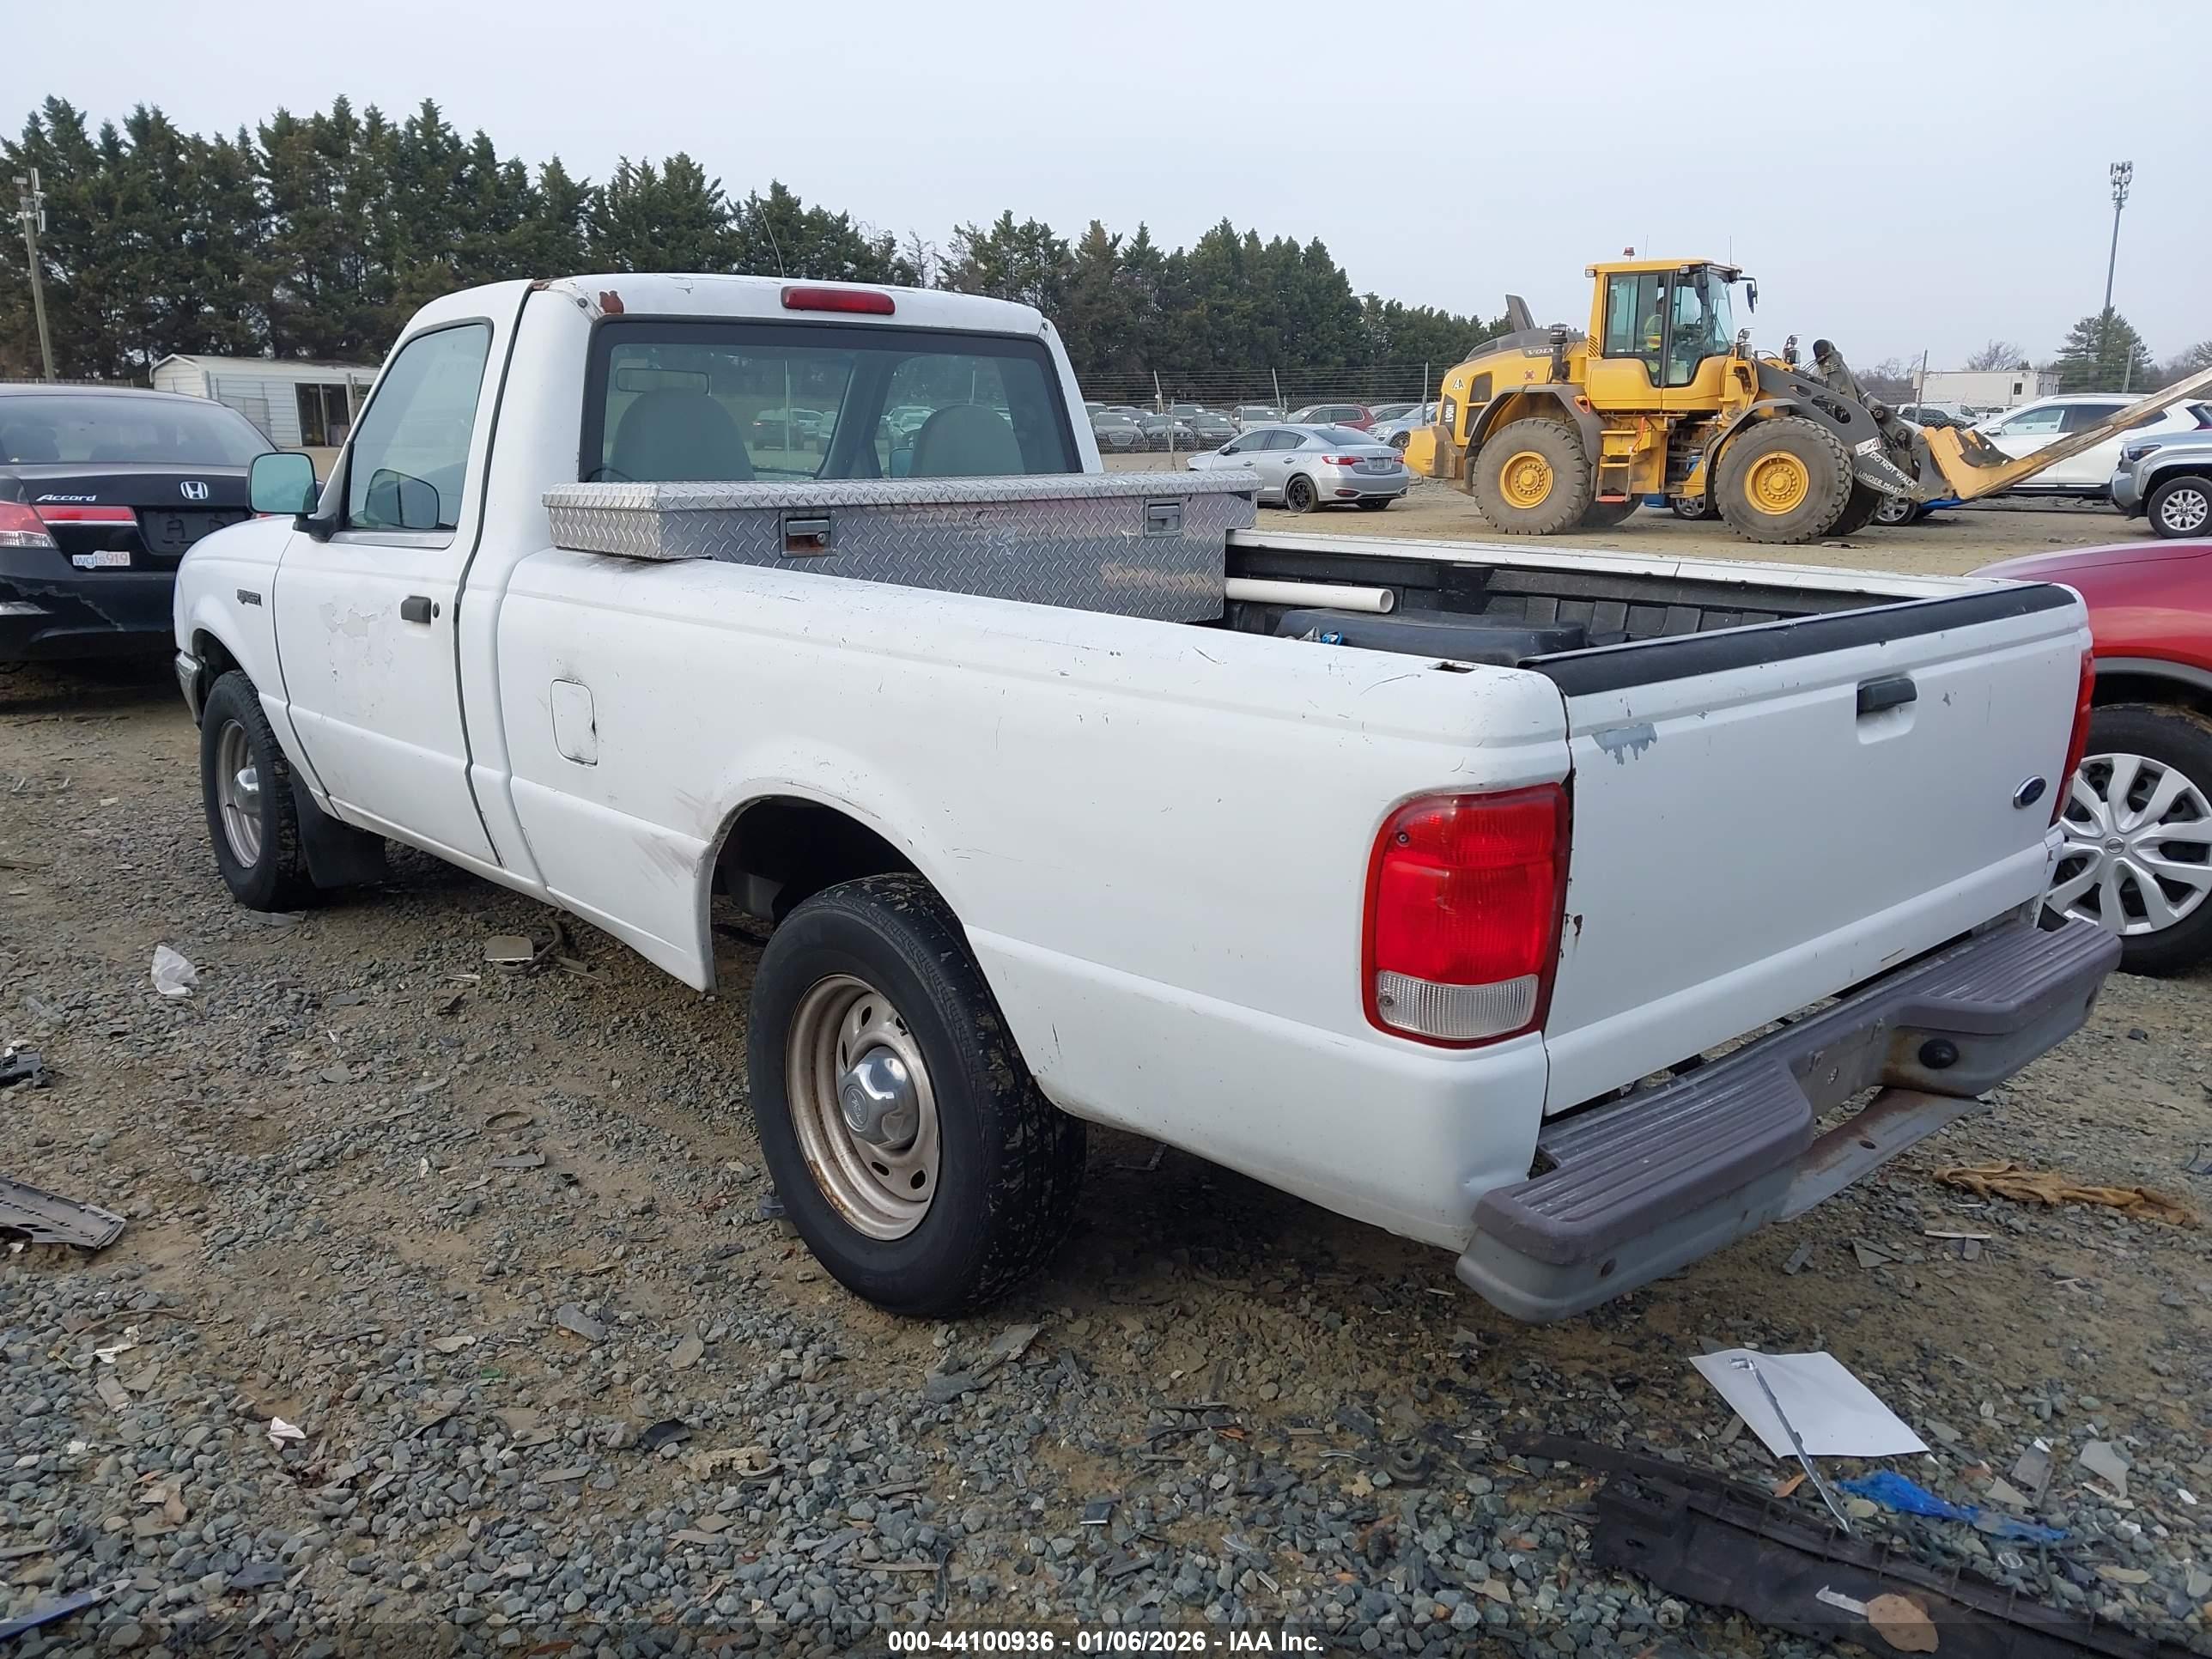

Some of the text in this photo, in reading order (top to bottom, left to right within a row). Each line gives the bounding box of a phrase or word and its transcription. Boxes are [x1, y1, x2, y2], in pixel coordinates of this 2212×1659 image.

[1444, 404, 1455, 422] L90H
[1858, 470, 1883, 487] UNDER
[1869, 451, 1917, 489] DO NOT WALK
[36, 494, 97, 502] Accord
